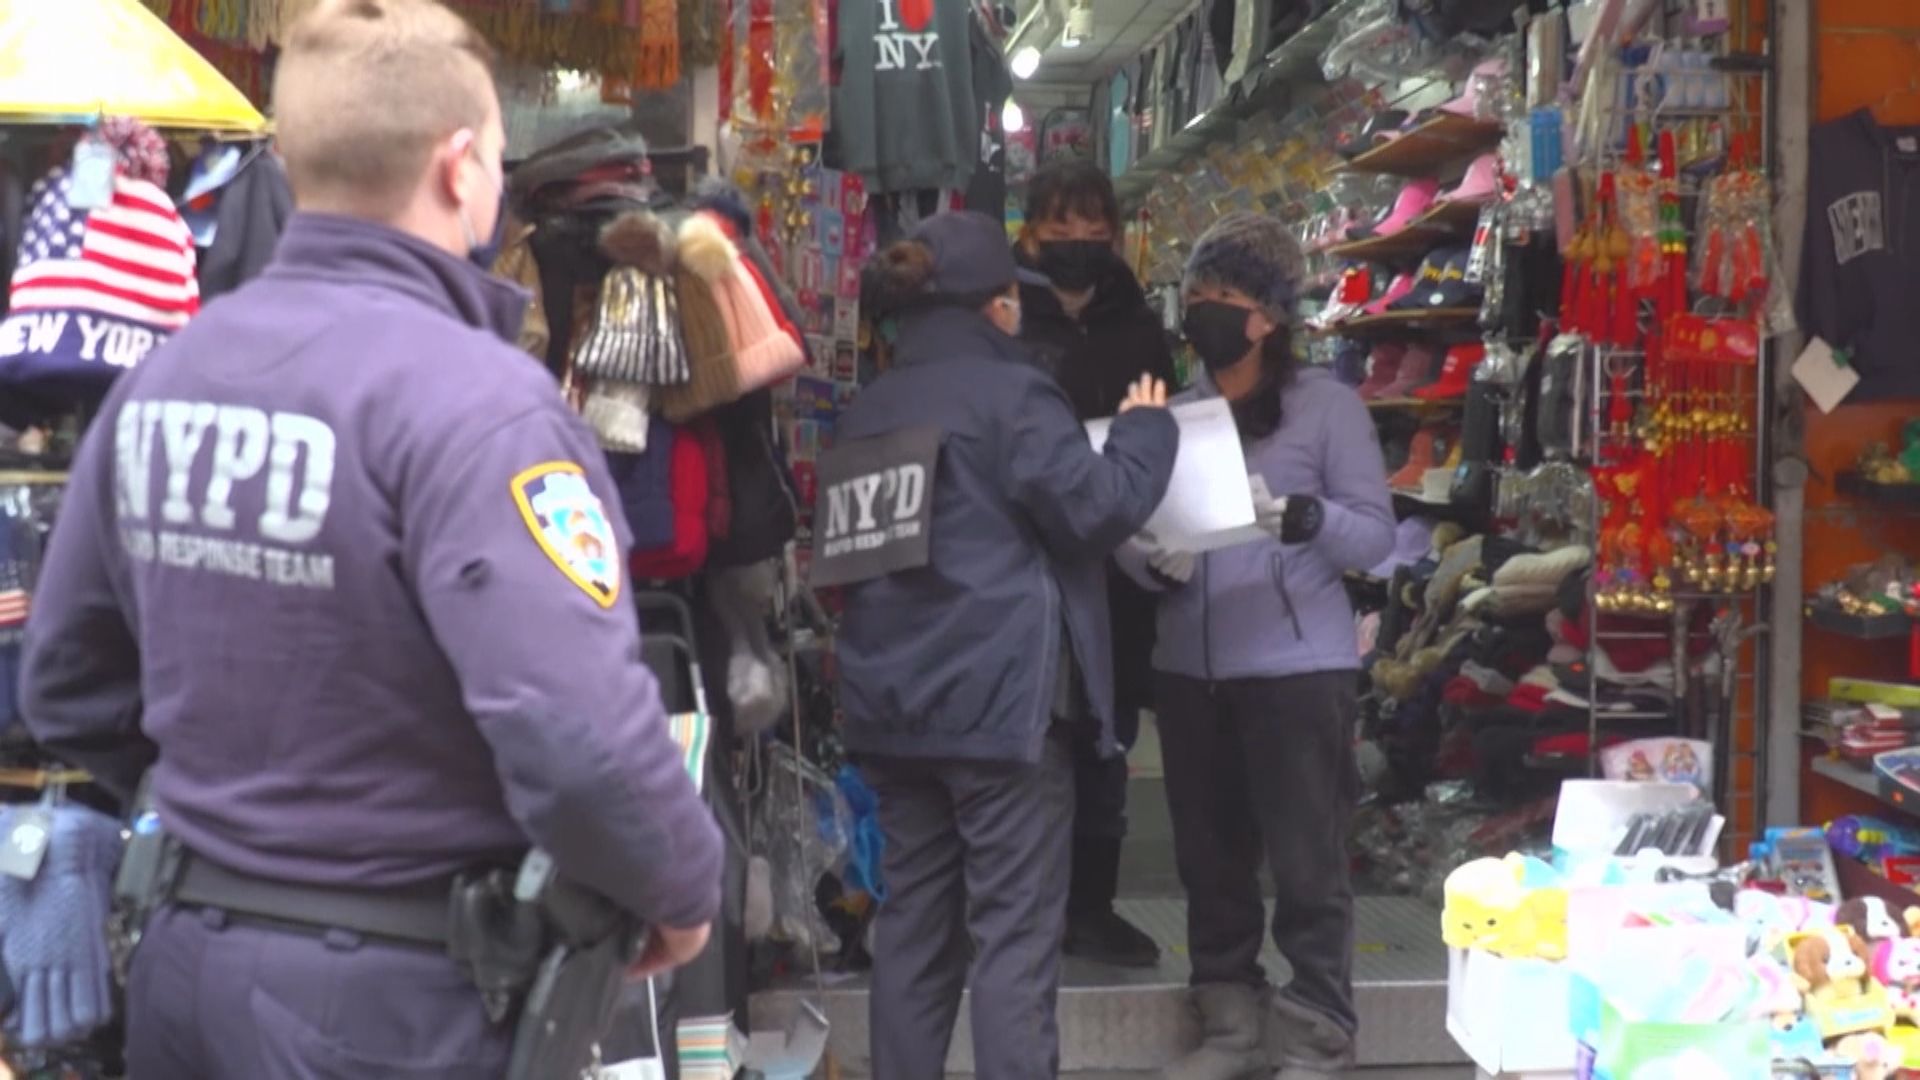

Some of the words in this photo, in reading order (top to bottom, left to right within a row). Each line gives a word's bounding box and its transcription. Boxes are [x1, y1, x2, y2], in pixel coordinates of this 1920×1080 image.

[879, 0, 898, 29] I
[873, 32, 939, 69] NY
[0, 312, 69, 357] EW
[77, 314, 168, 368] YOR
[115, 399, 336, 543] NYPD
[264, 548, 335, 588] TEAM
